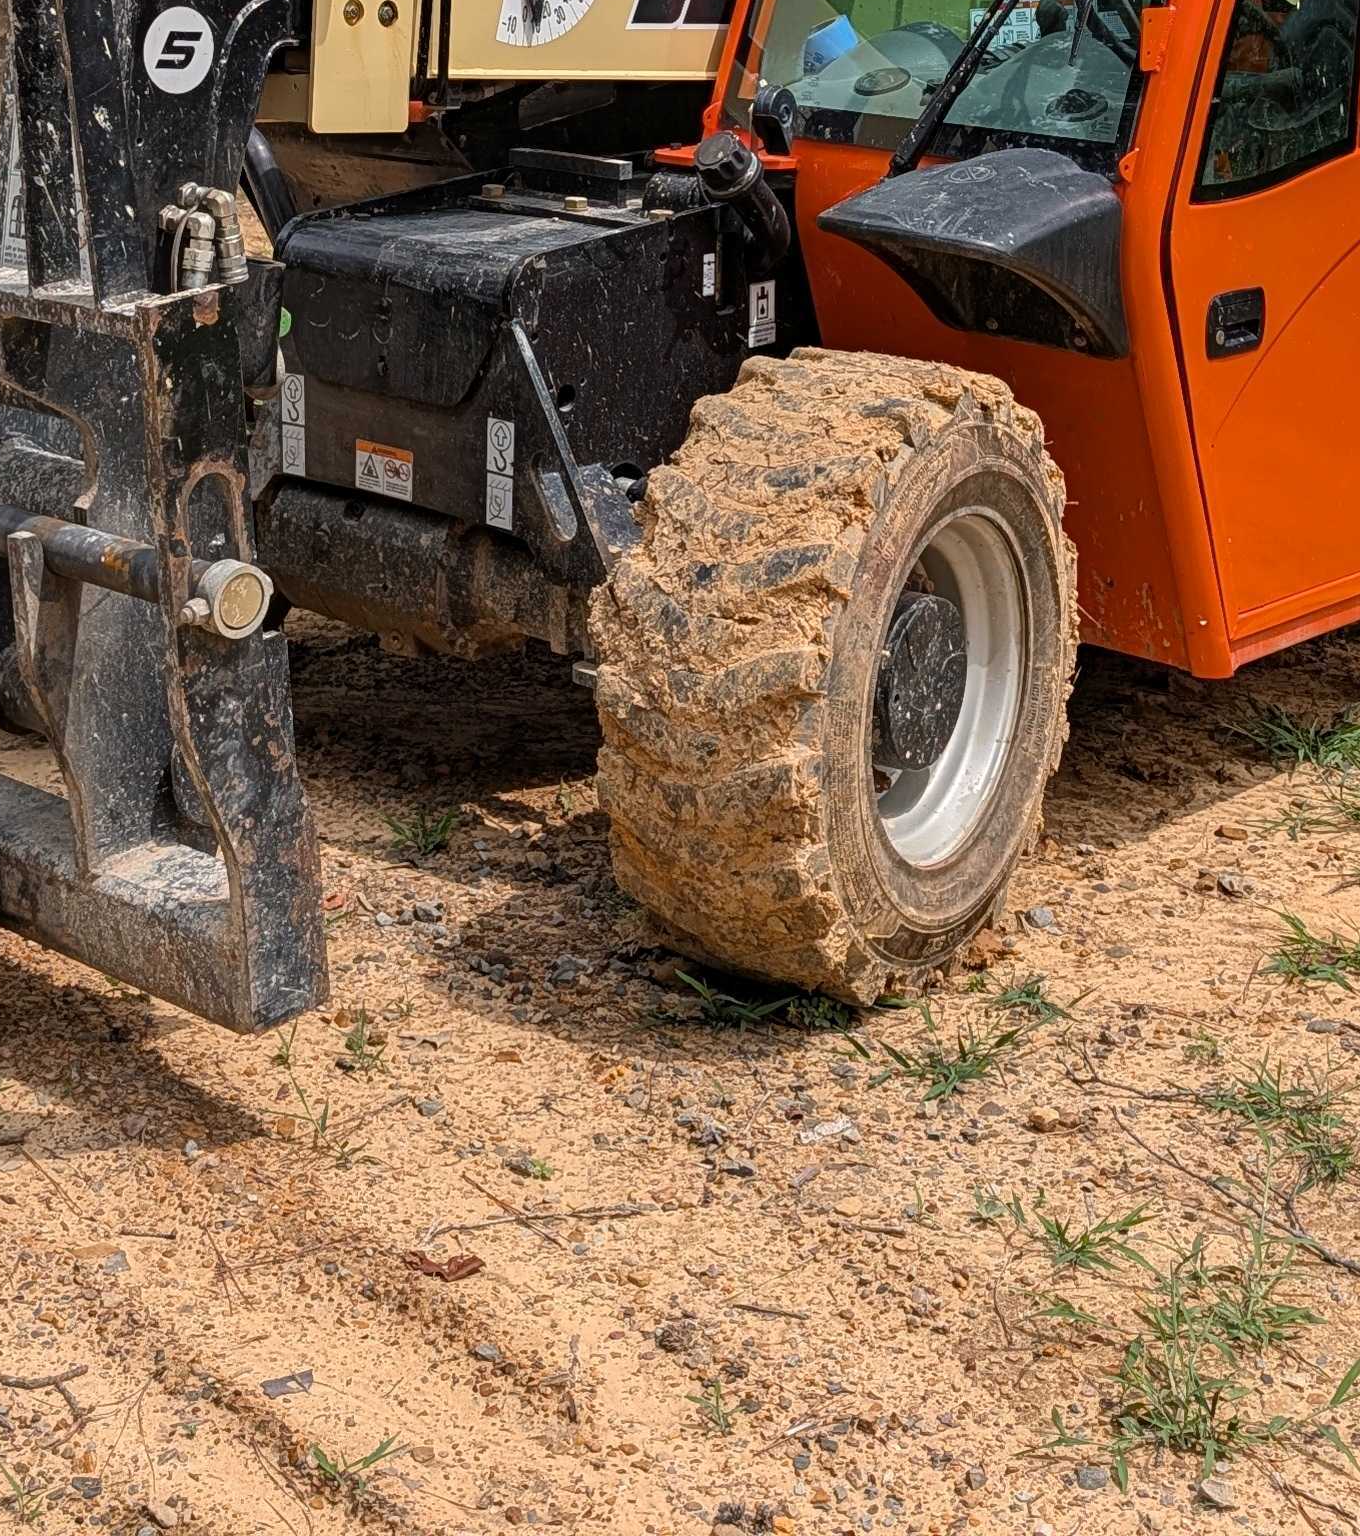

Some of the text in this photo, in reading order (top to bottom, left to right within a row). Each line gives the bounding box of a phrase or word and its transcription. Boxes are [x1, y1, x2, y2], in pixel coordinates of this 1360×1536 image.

[502, 15, 517, 34] -10
[522, 5, 528, 23] 0
[542, 0, 551, 19] 20
[554, 5, 566, 25] 30
[154, 30, 204, 70] 5
